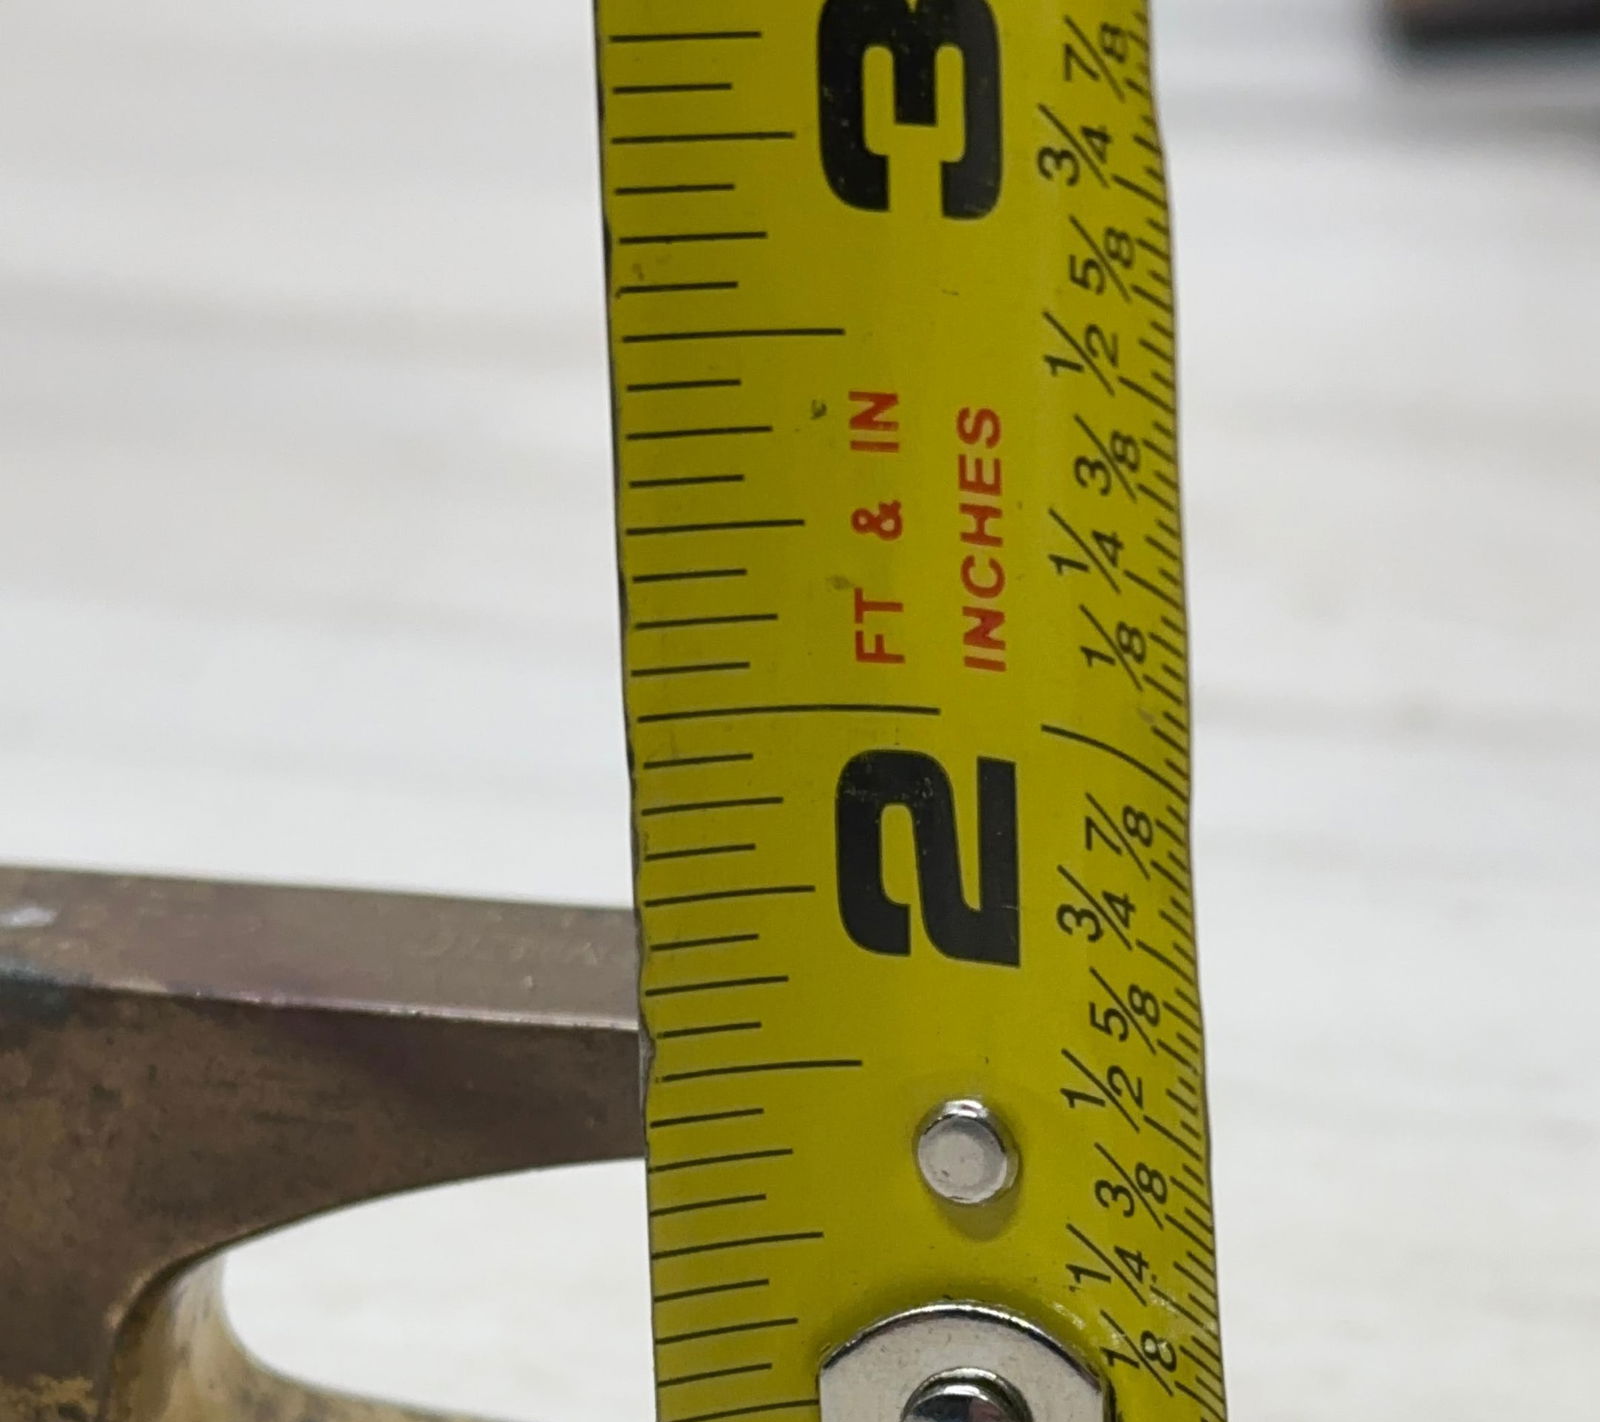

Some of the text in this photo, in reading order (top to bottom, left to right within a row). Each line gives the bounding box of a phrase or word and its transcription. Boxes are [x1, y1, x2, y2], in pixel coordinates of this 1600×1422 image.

[1064, 15, 1128, 103] 7/8
[818, 0, 1003, 220] 3
[1038, 103, 1112, 188] 3/4
[1069, 215, 1135, 302] 5/8
[1043, 310, 1119, 396] 1/2
[1074, 414, 1141, 502] 3/8
[849, 391, 905, 664] FT & IN
[956, 407, 1006, 672] INCHES
[1049, 508, 1123, 594] 1/4
[1080, 605, 1147, 692] 1/8
[835, 749, 1020, 968] 2
[1084, 792, 1153, 880] 7/8
[1057, 865, 1136, 951] 3/4
[1089, 967, 1160, 1054] 5/8
[1060, 1048, 1143, 1133] 1/2
[1094, 1142, 1167, 1231] 3/8
[1066, 1223, 1149, 1306] 1/4
[1101, 1310, 1177, 1397] 1/8
